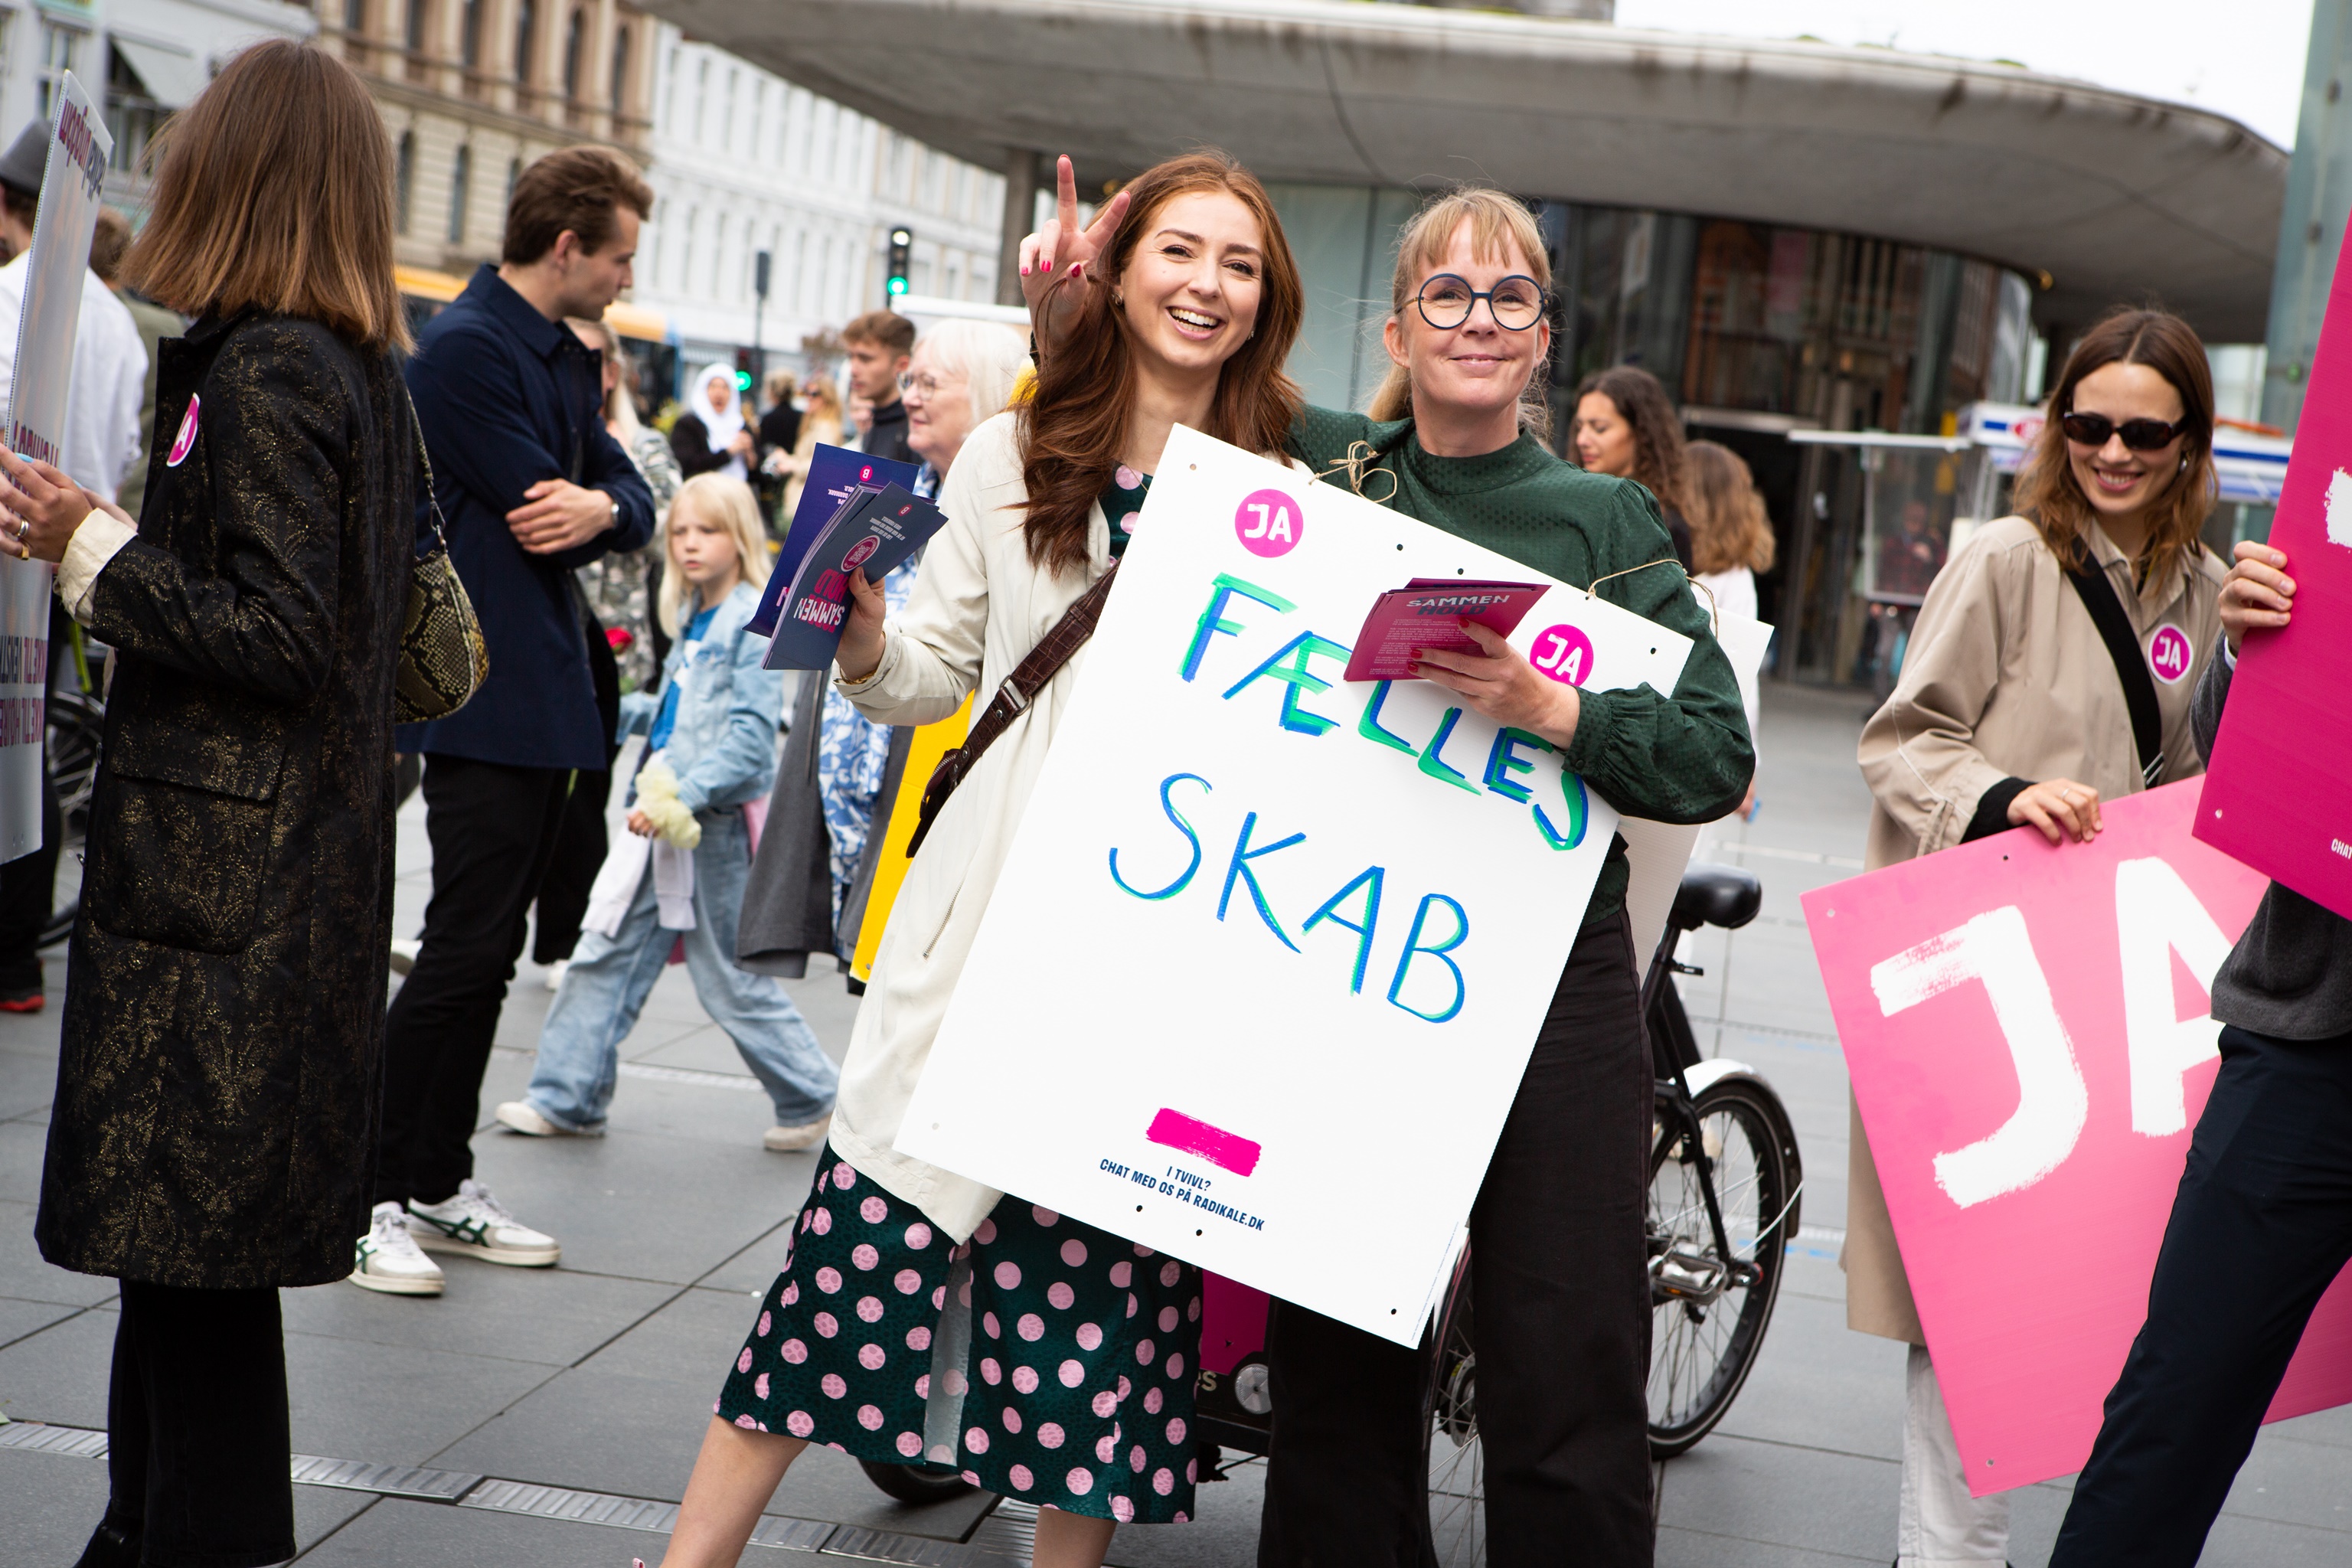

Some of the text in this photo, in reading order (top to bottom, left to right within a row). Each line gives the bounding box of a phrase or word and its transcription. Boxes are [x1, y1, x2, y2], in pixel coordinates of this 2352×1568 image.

[862, 469, 870, 479] B
[1243, 503, 1292, 544] JA
[814, 568, 849, 603] HOLD
[1406, 595, 1510, 607] SAMMEN
[793, 598, 845, 626] SAMMEN
[1417, 606, 1487, 616] HOLD
[1536, 633, 1583, 685] JA
[2155, 635, 2181, 672] JA
[1109, 773, 1468, 1023] SKAB
[1870, 856, 2236, 1210] JA
[1099, 1158, 1265, 1231] CHAT MED OS PÅ RADIKALE.DK
[1166, 1166, 1211, 1192] I TVIVL?
